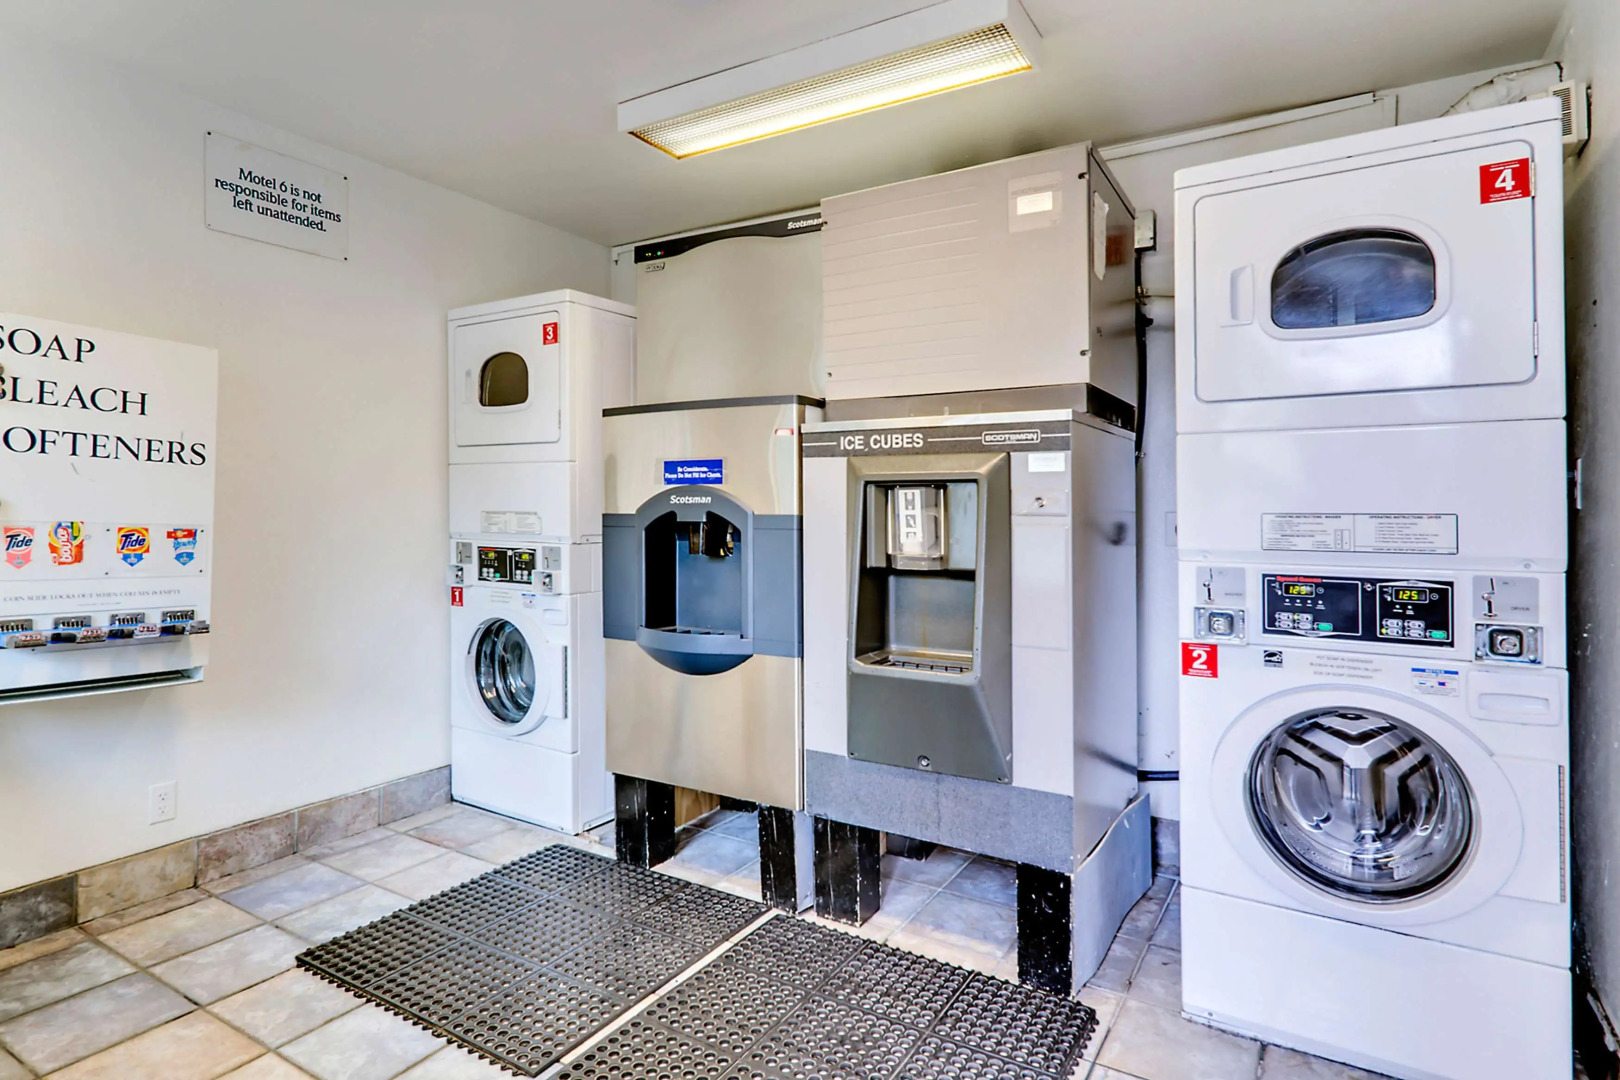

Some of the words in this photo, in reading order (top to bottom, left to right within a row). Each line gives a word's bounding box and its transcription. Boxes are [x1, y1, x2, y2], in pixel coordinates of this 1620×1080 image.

[238, 167, 276, 190] Motel
[279, 181, 288, 193] 6
[290, 183, 300, 197] is
[302, 189, 322, 204] not
[1494, 169, 1516, 191] 4
[214, 178, 288, 208] responsible
[291, 198, 308, 213] for
[310, 204, 342, 223] items
[232, 196, 254, 212] left
[256, 204, 327, 232] unattended.
[546, 326, 554, 340] 3
[0, 324, 96, 363] OAP
[839, 435, 864, 450] ICE
[869, 432, 924, 449] CUBES
[985, 432, 1037, 442] SCOTSMAN
[670, 495, 712, 504] Scotsman
[5, 533, 34, 551] Tide
[120, 532, 147, 551] Tide
[1398, 590, 1419, 600] 125
[1191, 649, 1208, 670] 2
